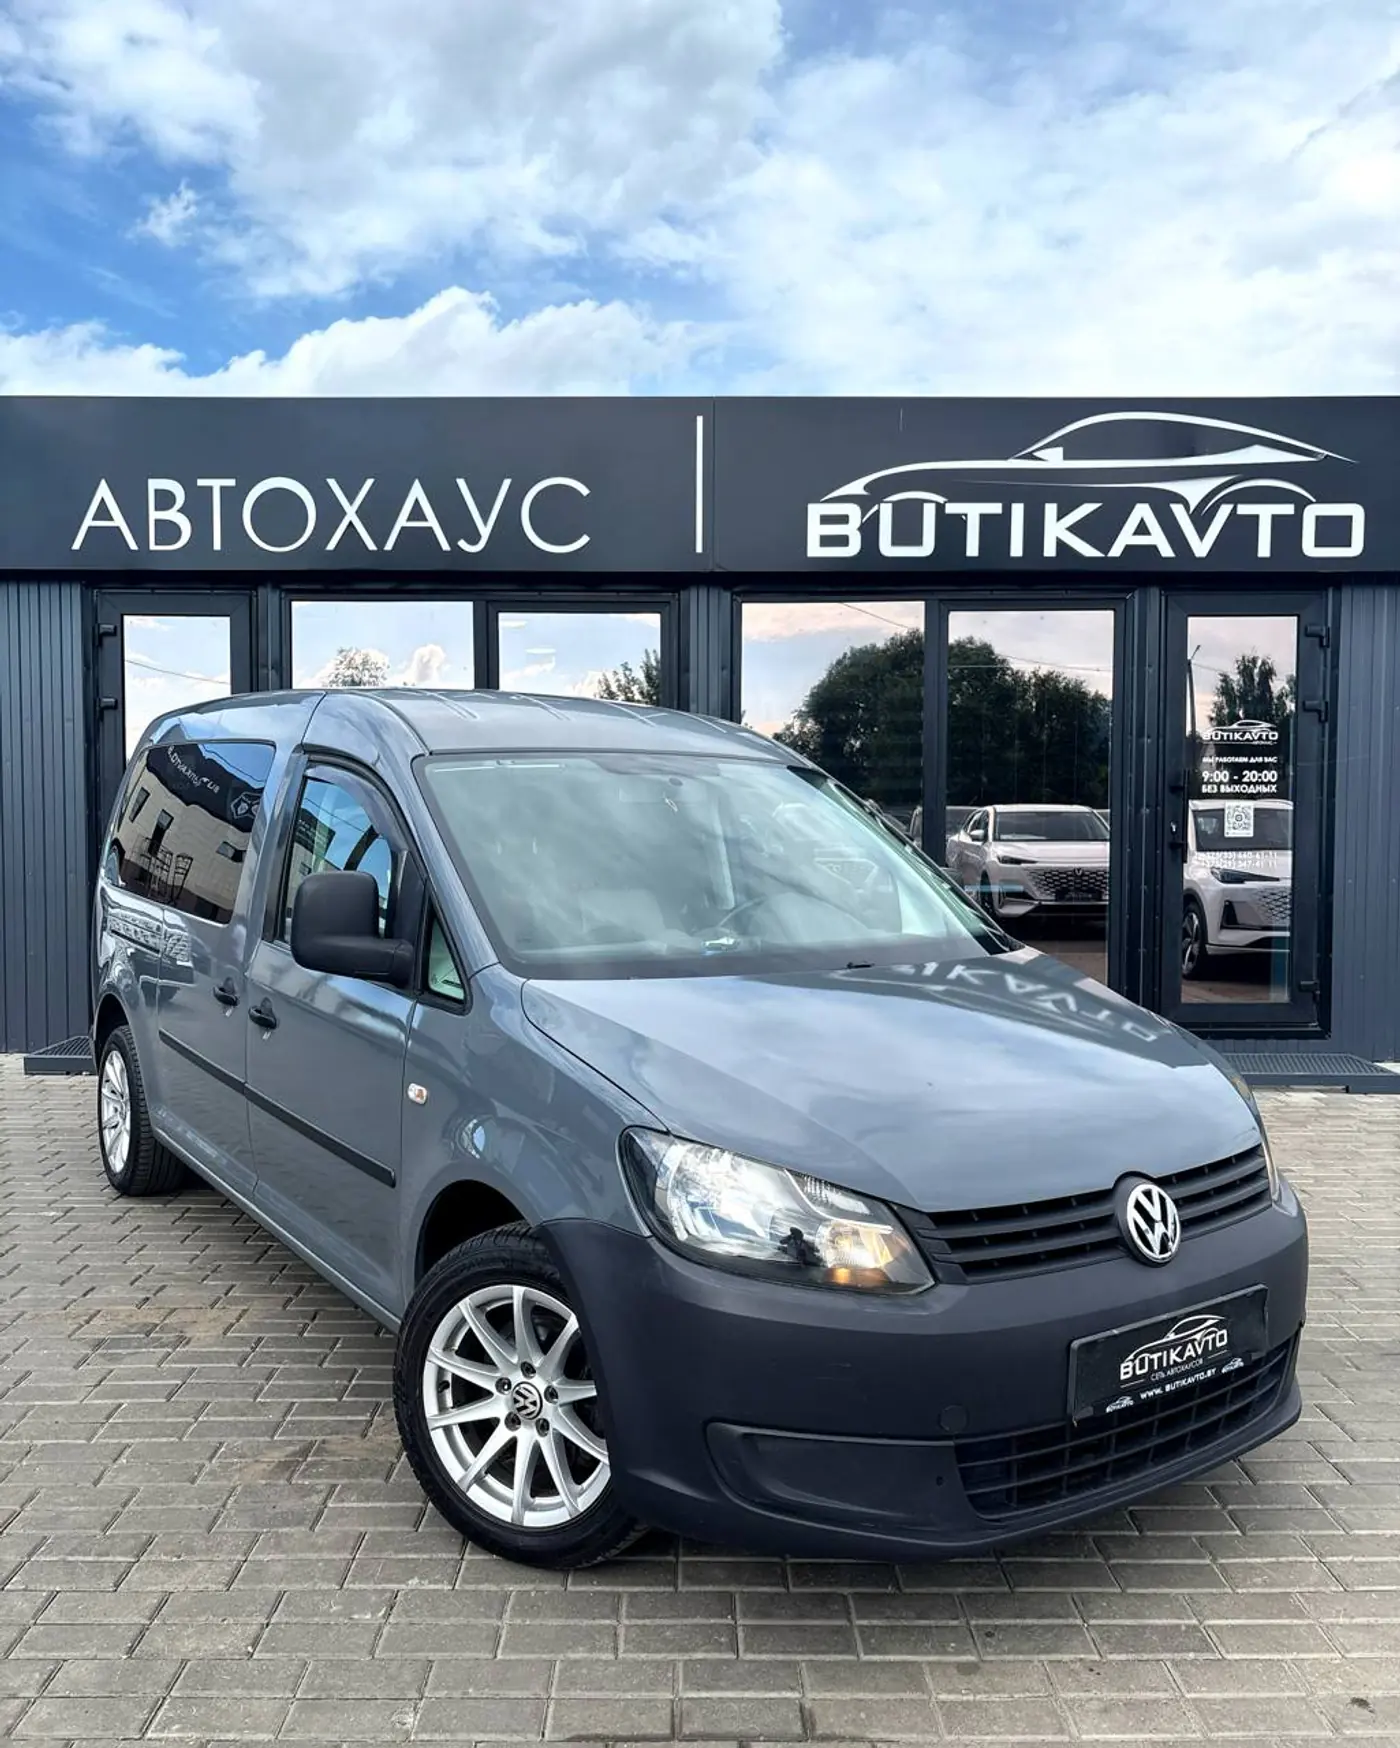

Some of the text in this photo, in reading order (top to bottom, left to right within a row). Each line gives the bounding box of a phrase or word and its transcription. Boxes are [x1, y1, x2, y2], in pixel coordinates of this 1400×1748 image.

[71, 476, 591, 553] АВТОХАУС
[806, 502, 1365, 558] BUTIKAVTO
[1202, 770, 1229, 782] 9:00
[1241, 770, 1278, 782] 20:00
[1202, 784, 1277, 794] БЕЗ ВЫХОДНЫХ
[1120, 1329, 1228, 1381] BUTIKAVTO
